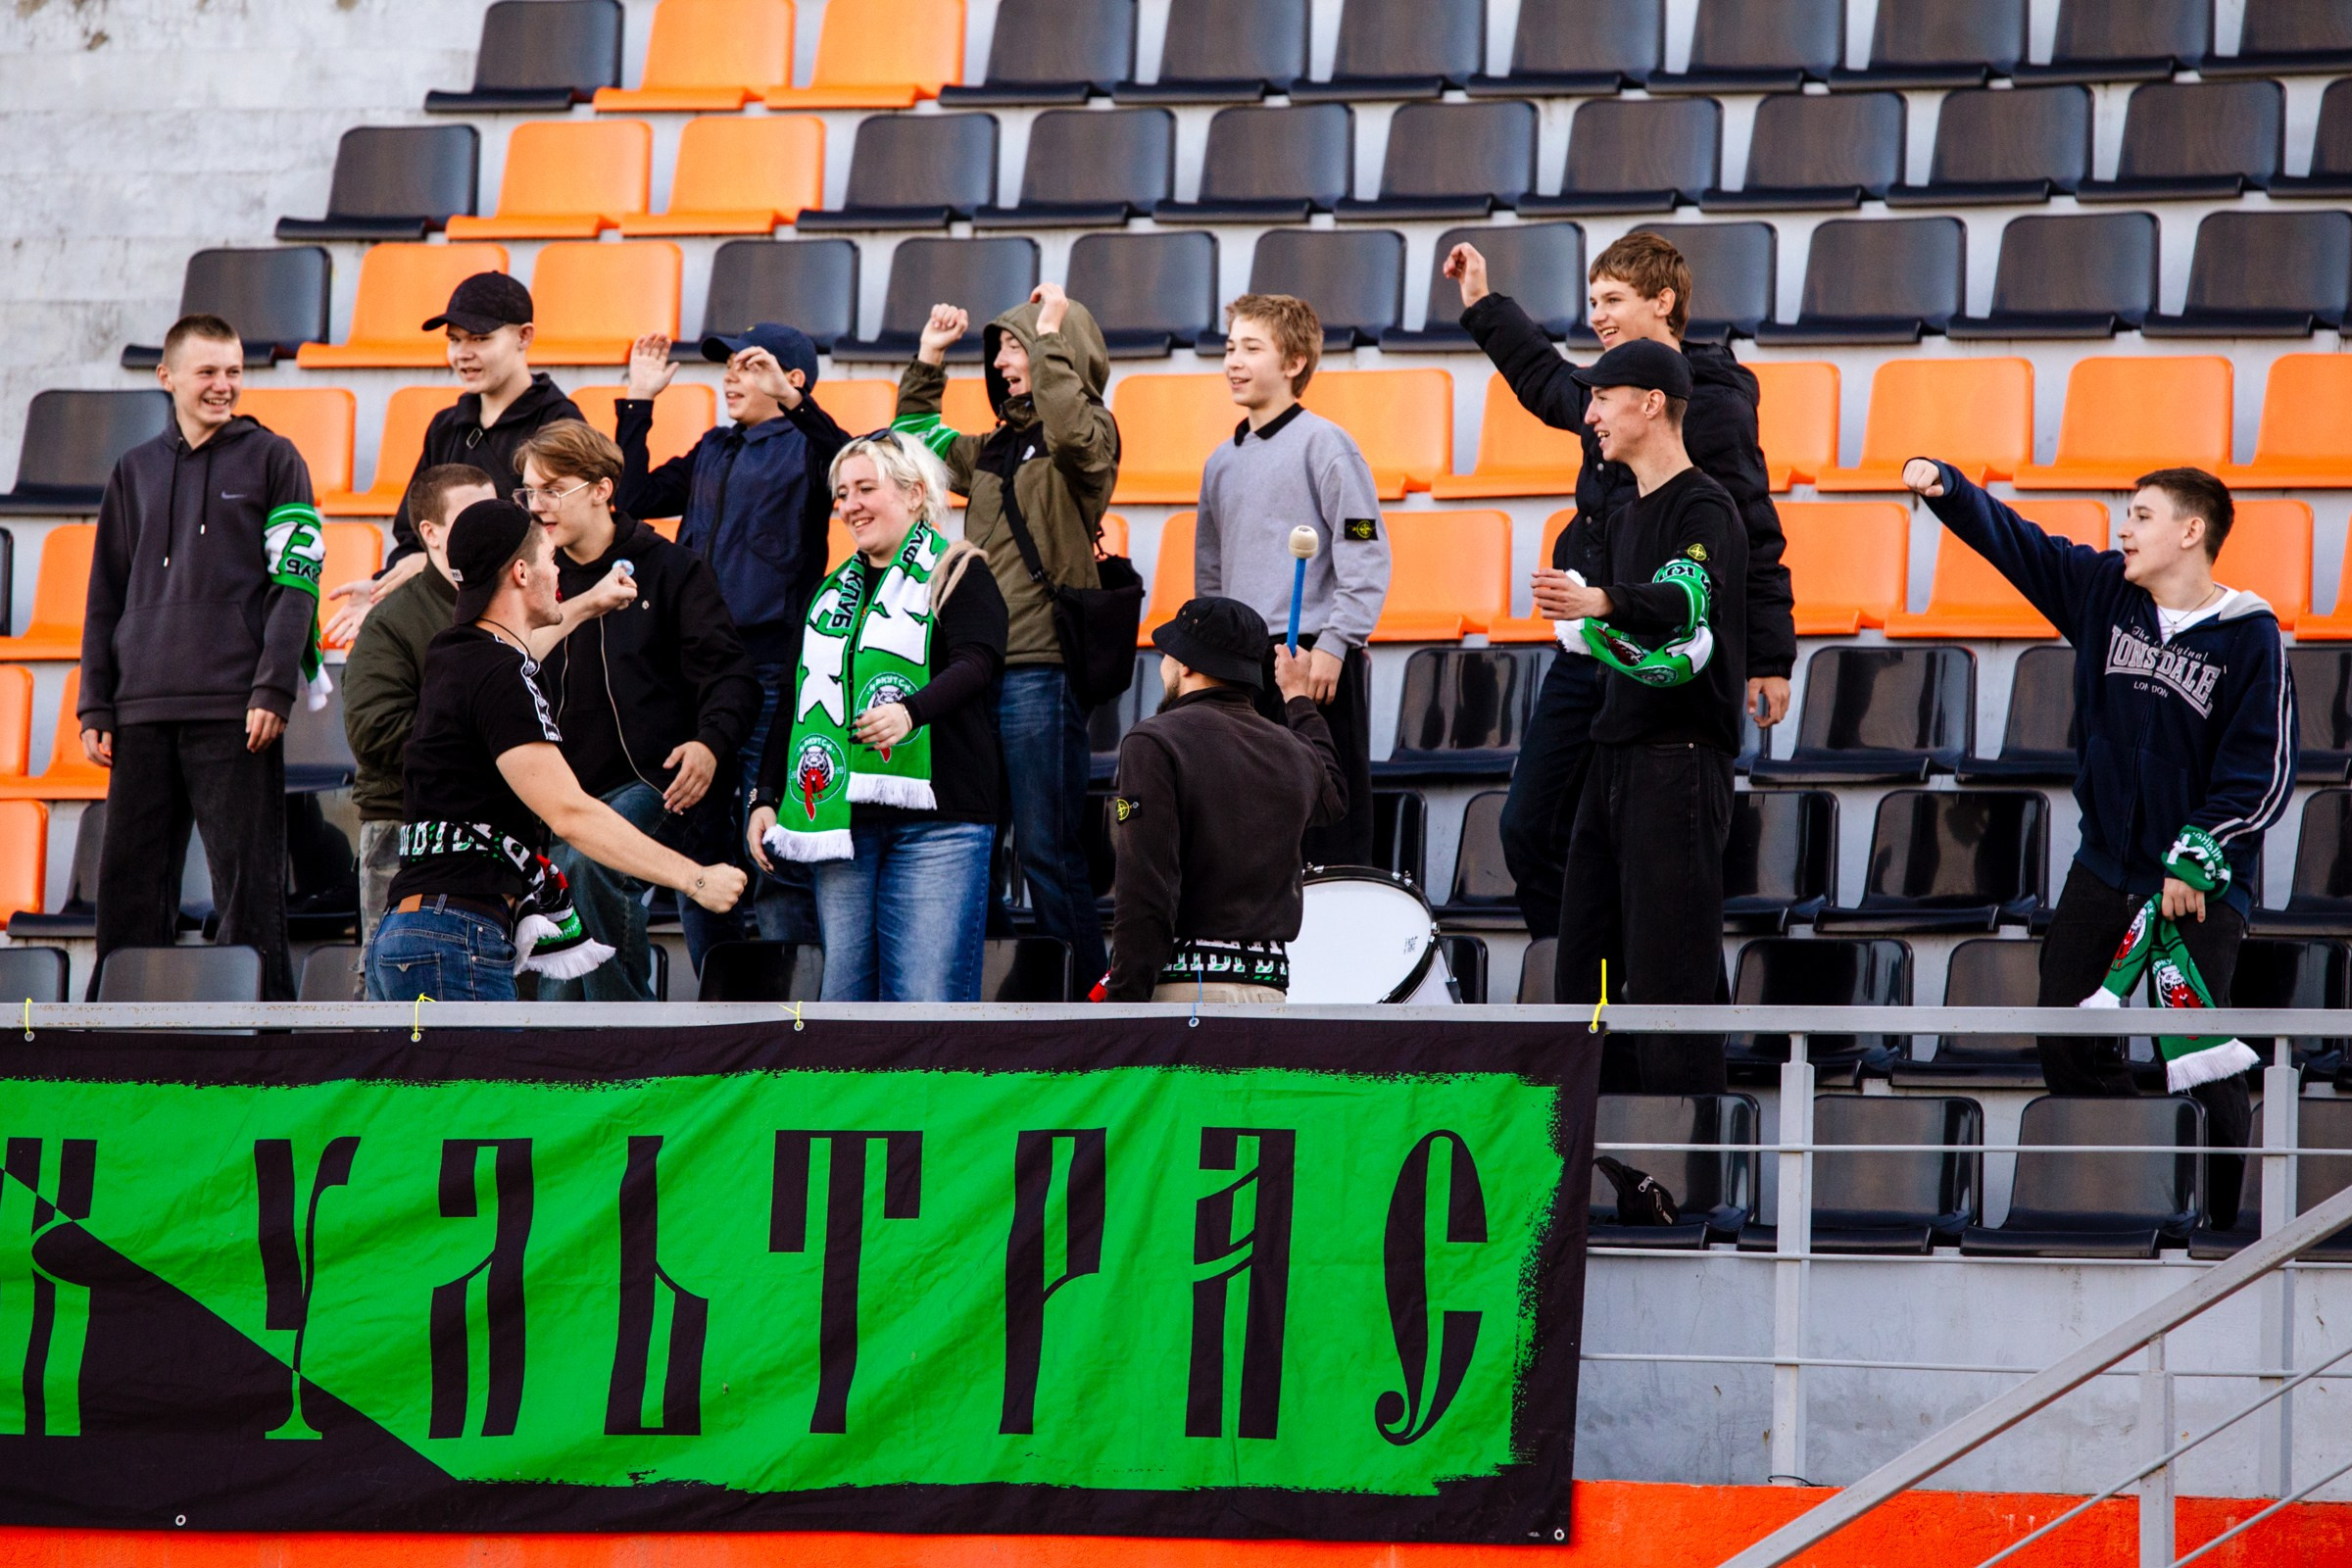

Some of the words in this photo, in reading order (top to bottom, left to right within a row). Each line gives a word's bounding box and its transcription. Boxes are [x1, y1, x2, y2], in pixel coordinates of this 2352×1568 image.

[831, 568, 864, 628] КЛУБ
[2132, 625, 2151, 642] The
[2104, 624, 2222, 710] LONSDALE
